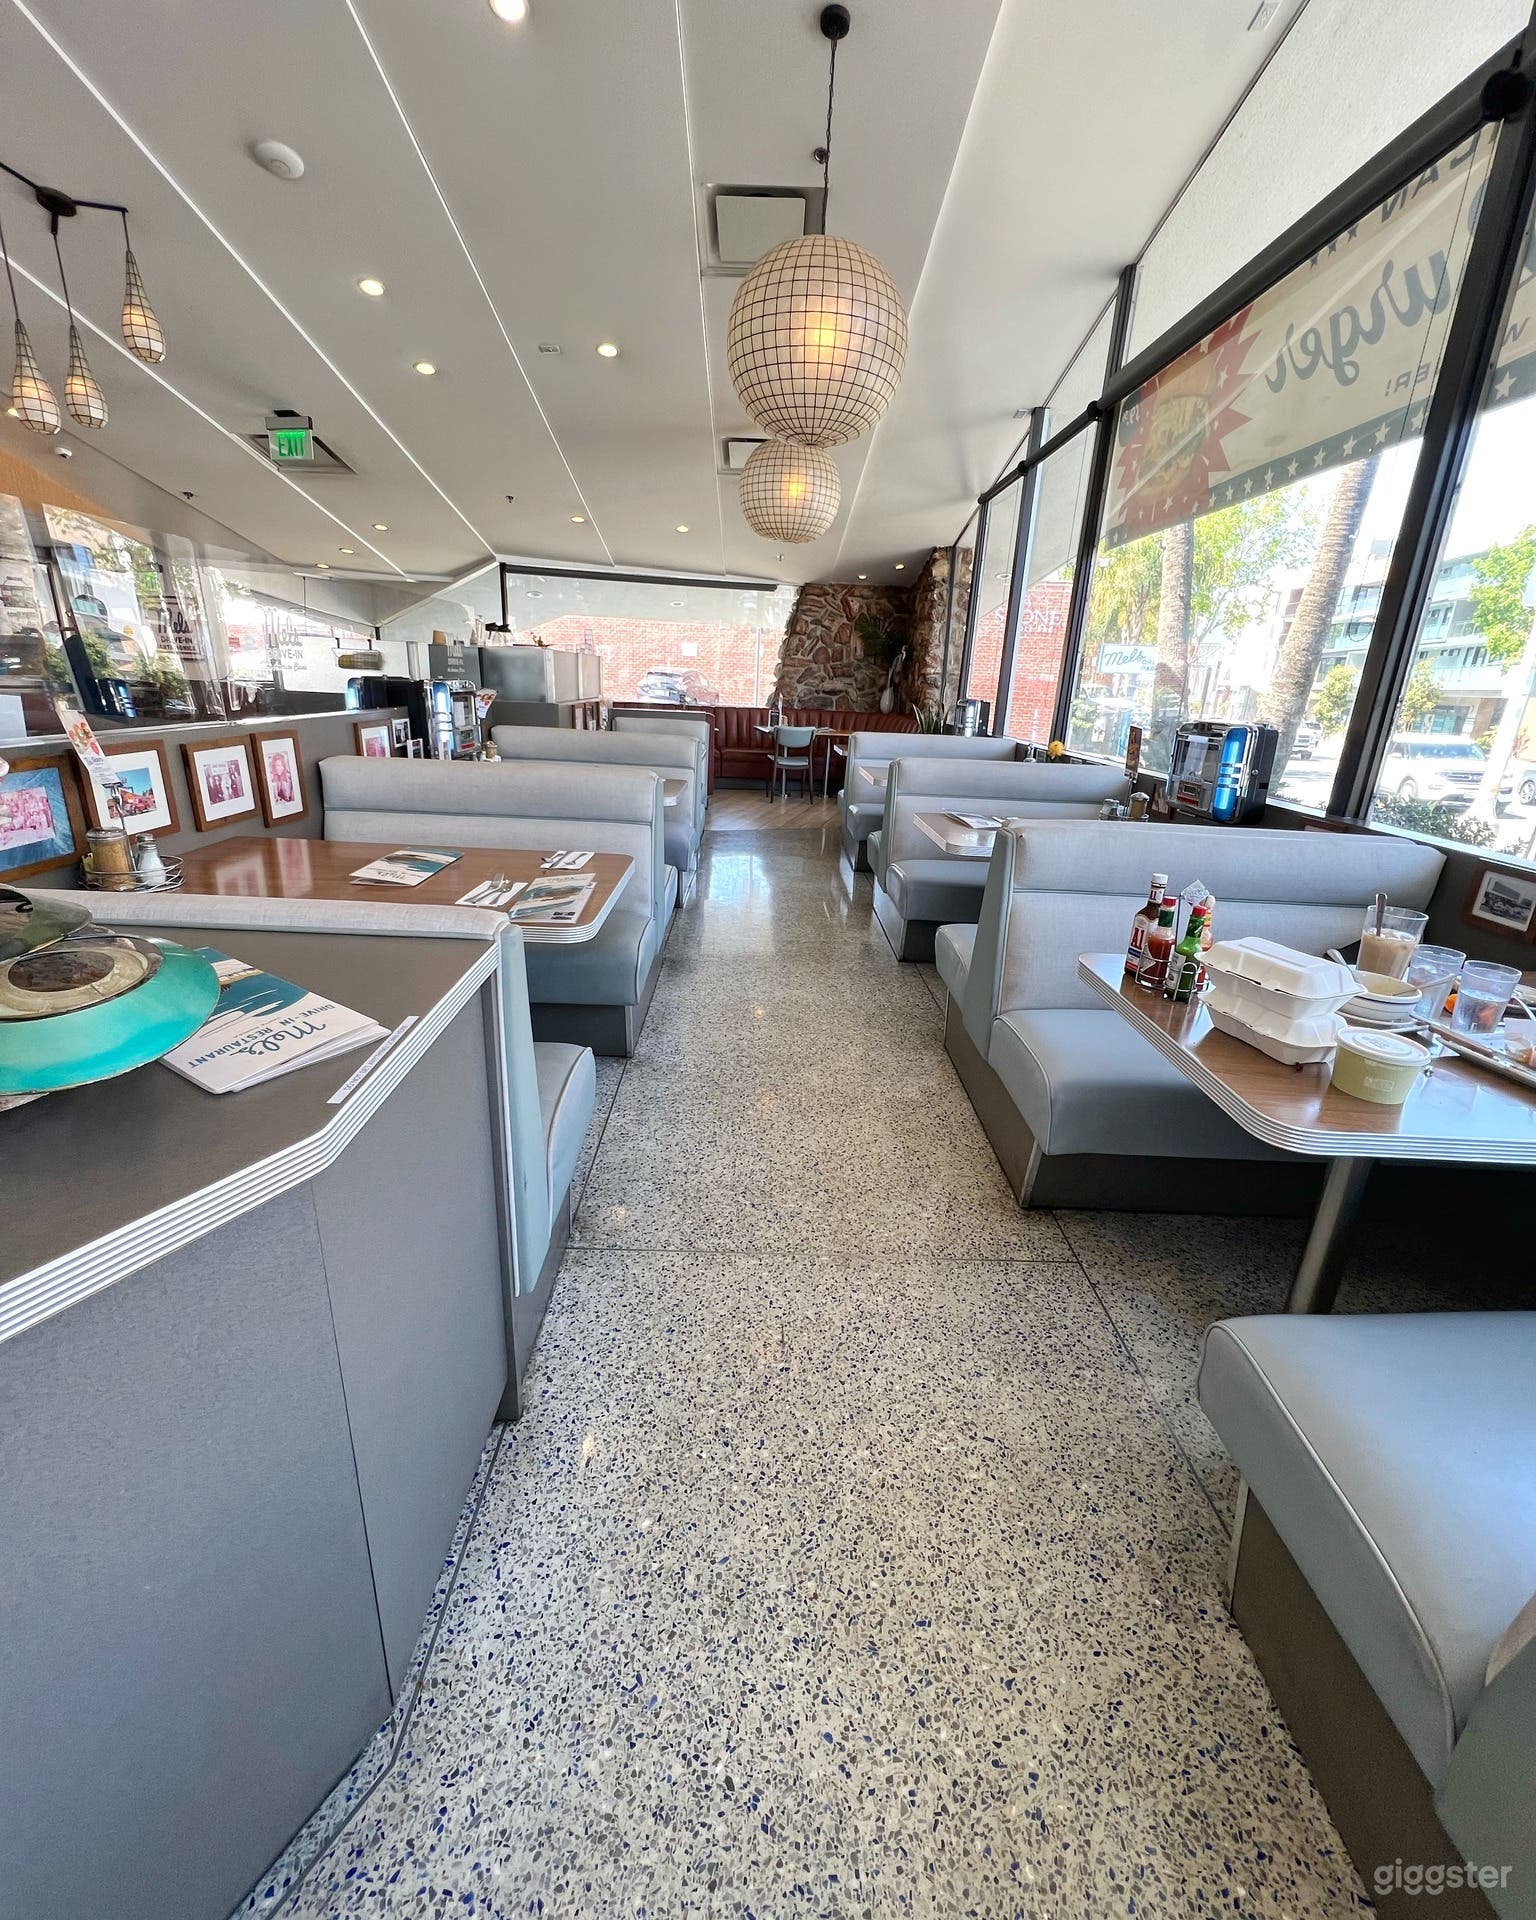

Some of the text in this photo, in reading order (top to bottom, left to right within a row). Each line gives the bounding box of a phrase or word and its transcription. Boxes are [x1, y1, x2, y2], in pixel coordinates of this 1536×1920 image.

[278, 431, 306, 457] EXIT
[160, 636, 193, 644] DRVE-IN
[279, 1003, 336, 1027] DRIVE-IN
[188, 1026, 273, 1070] RESTAURANT
